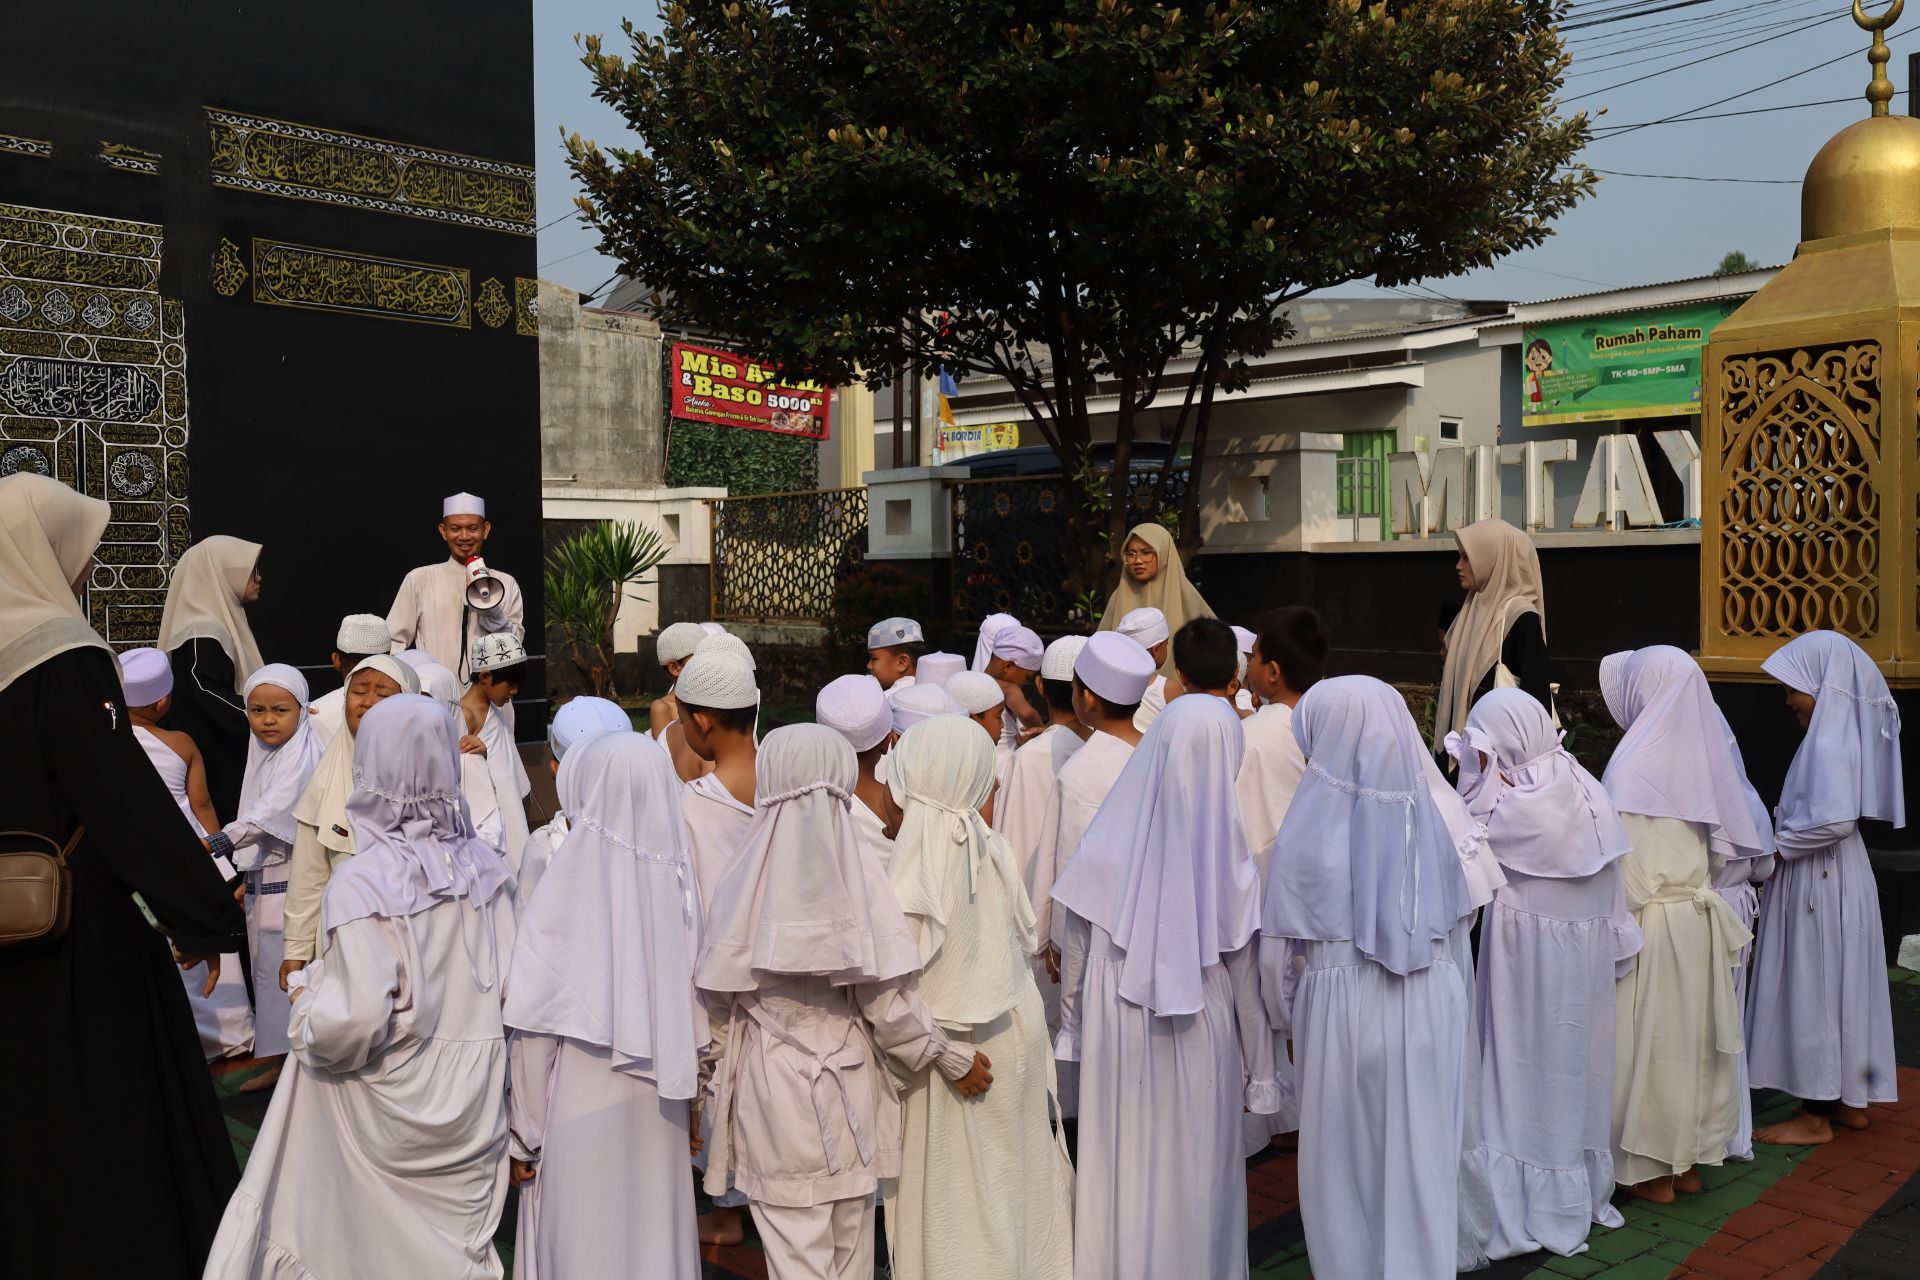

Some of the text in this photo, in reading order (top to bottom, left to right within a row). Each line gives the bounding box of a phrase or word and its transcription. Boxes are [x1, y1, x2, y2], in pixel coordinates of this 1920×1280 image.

[1595, 325, 1702, 350] Rumah Paham
[680, 350, 737, 379] Mie
[1611, 364, 1686, 379] TK-SD-SMP-SMA
[682, 372, 693, 386] &
[693, 374, 763, 406] Baso
[767, 394, 811, 413] 5000
[951, 430, 982, 442] BORDIR
